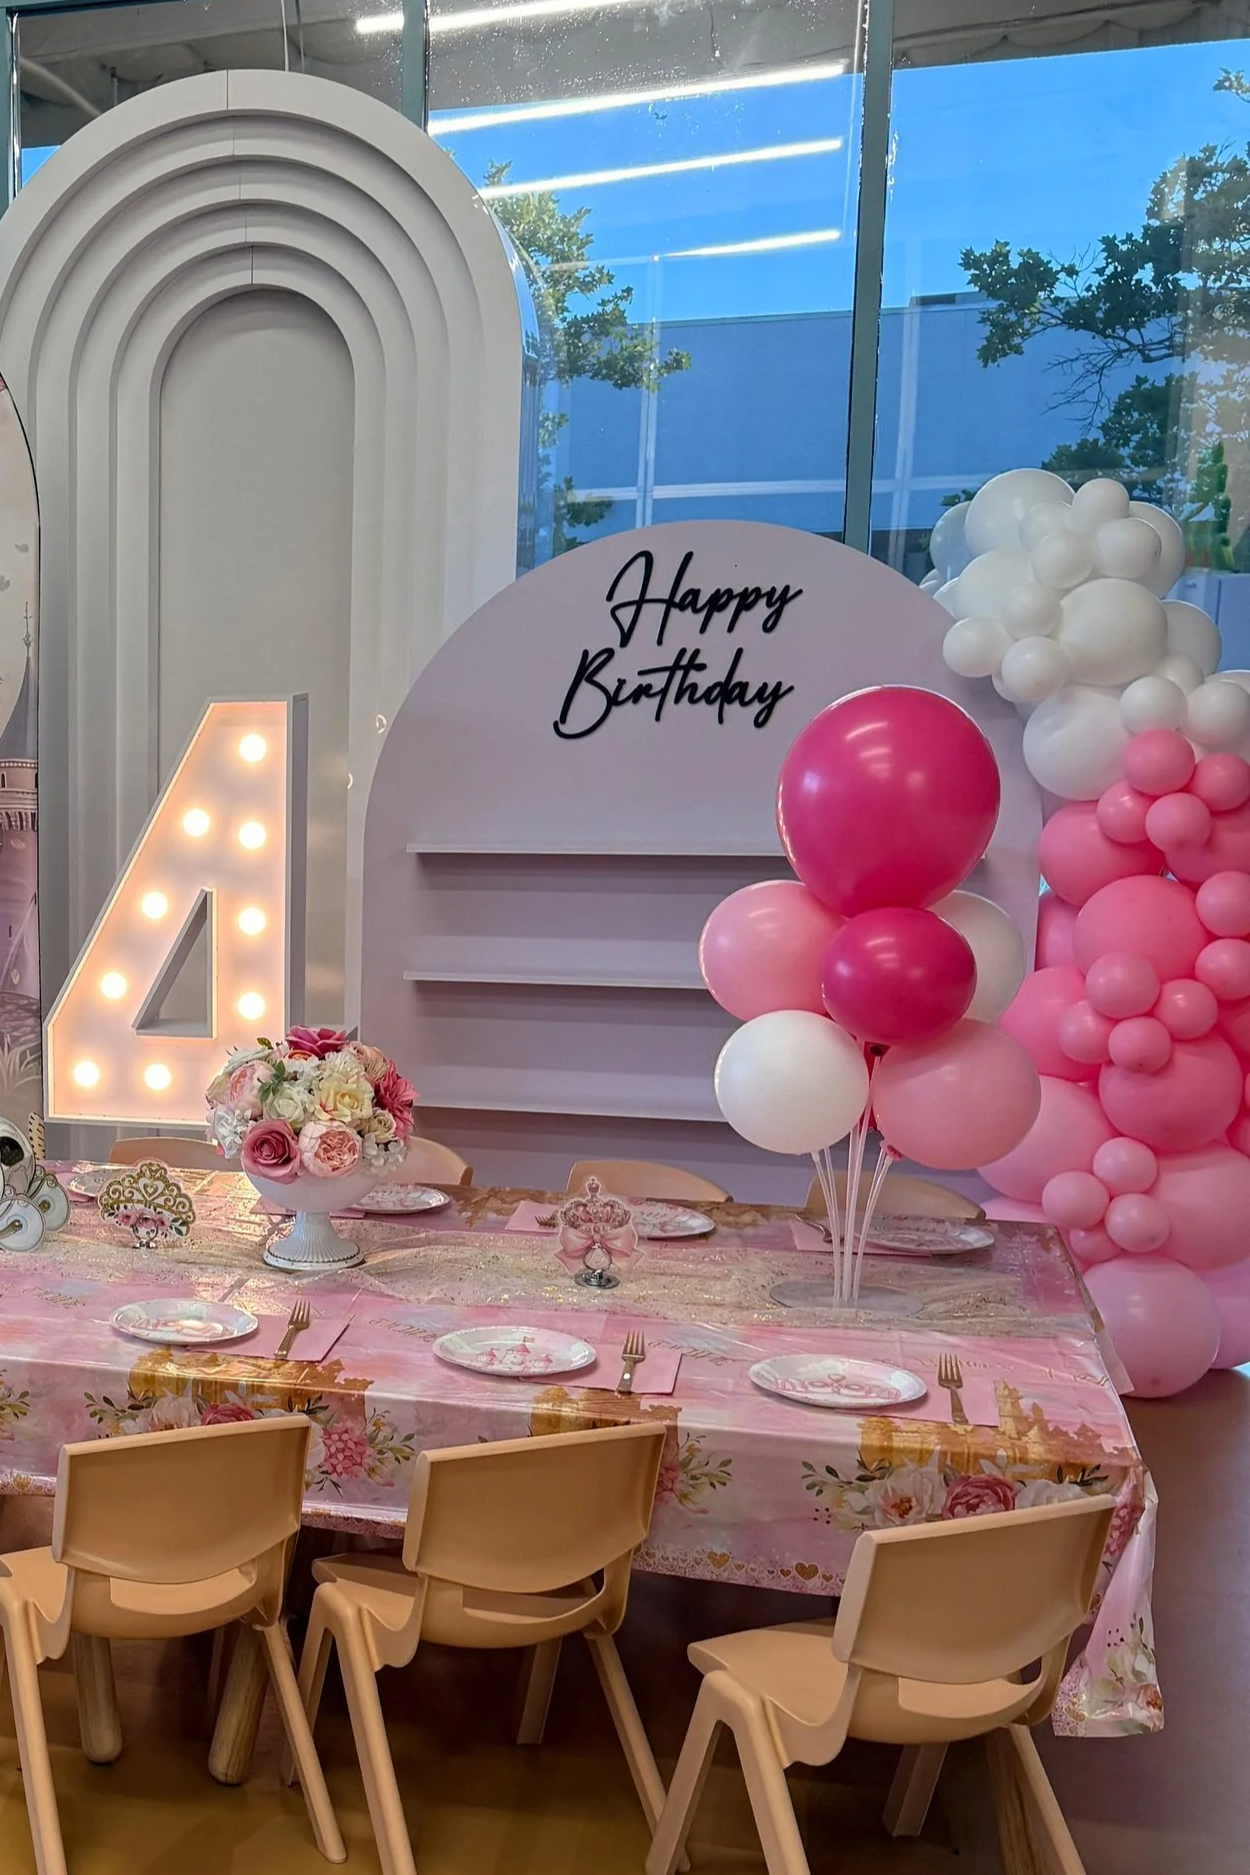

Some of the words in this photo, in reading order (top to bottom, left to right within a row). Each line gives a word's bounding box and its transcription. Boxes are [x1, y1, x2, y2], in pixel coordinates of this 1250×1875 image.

[605, 550, 804, 648] Happy
[553, 647, 795, 740] Birthday
[43, 694, 308, 1128] 4
